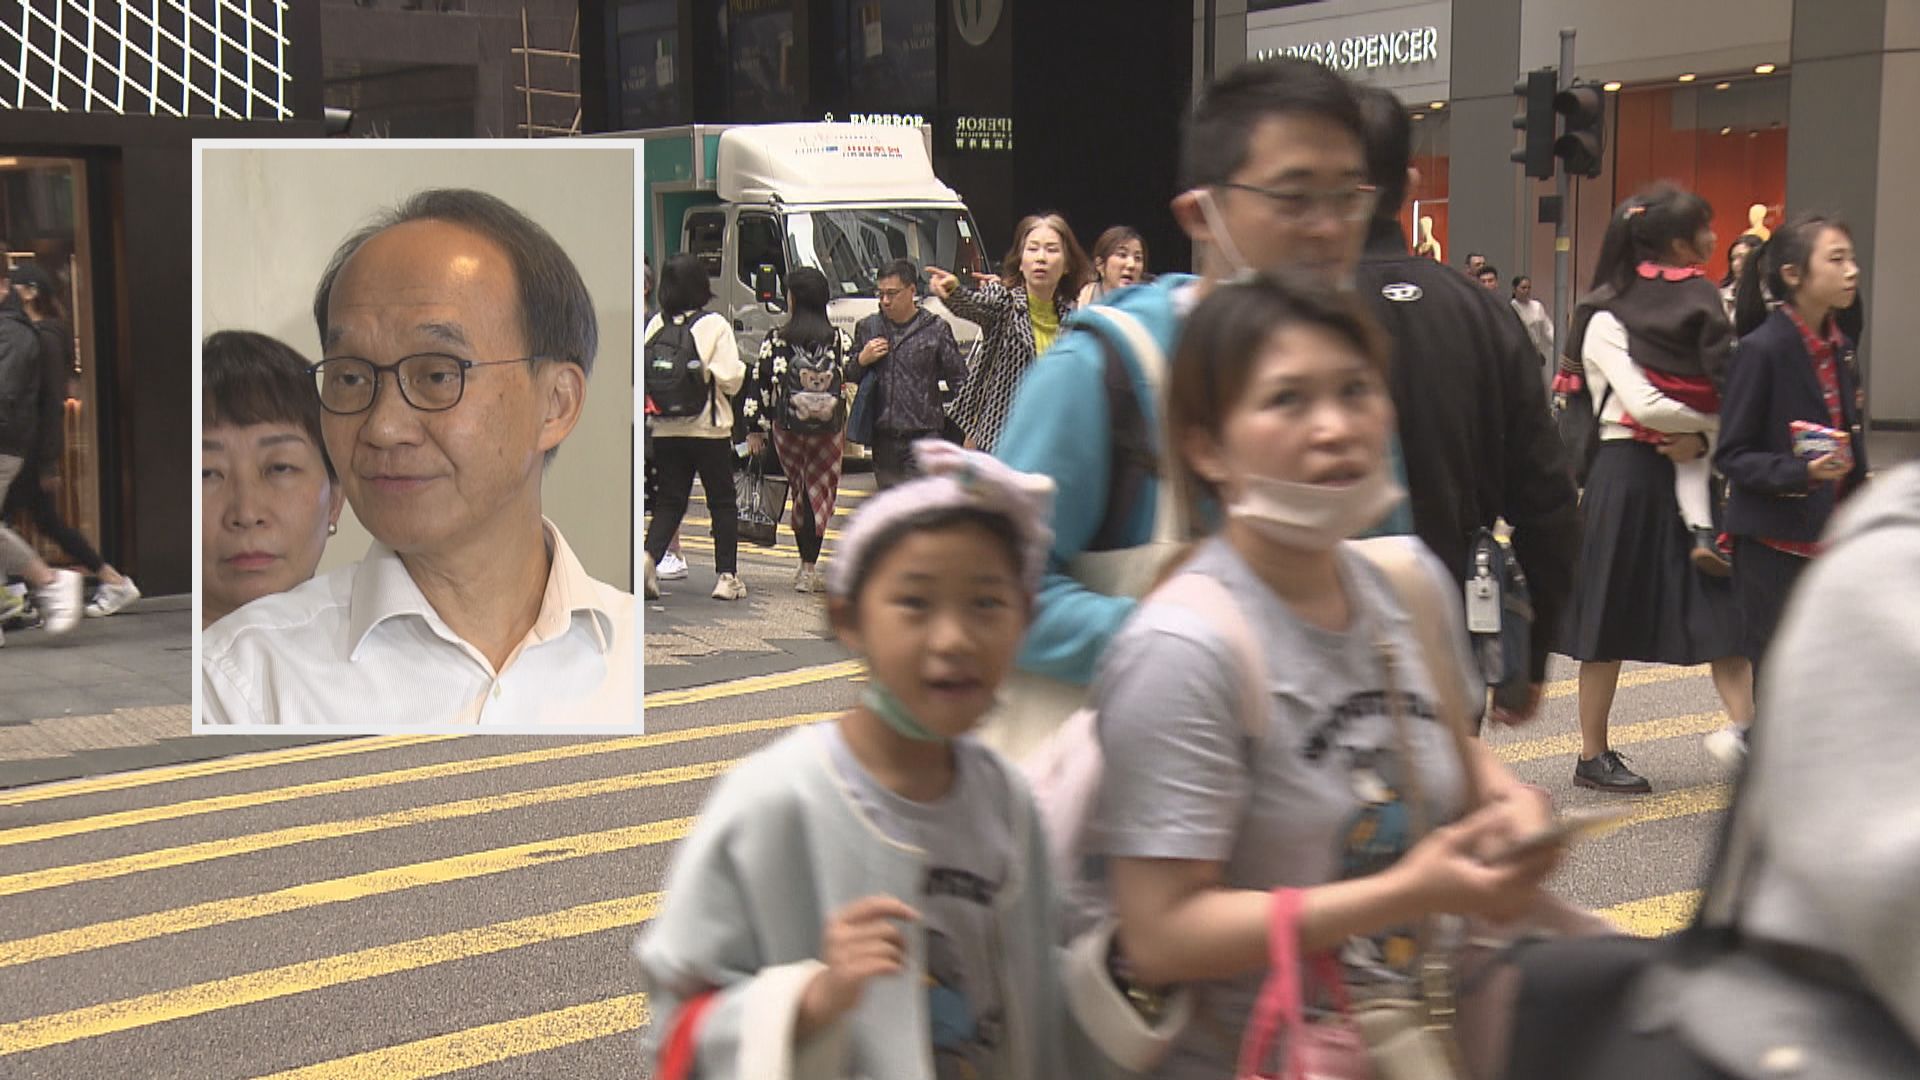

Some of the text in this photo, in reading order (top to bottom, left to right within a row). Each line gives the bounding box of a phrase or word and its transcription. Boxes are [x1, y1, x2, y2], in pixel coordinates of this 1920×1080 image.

[1325, 39, 1338, 71] &
[1341, 28, 1437, 70] SPENCER
[849, 113, 924, 128] EMPEROR
